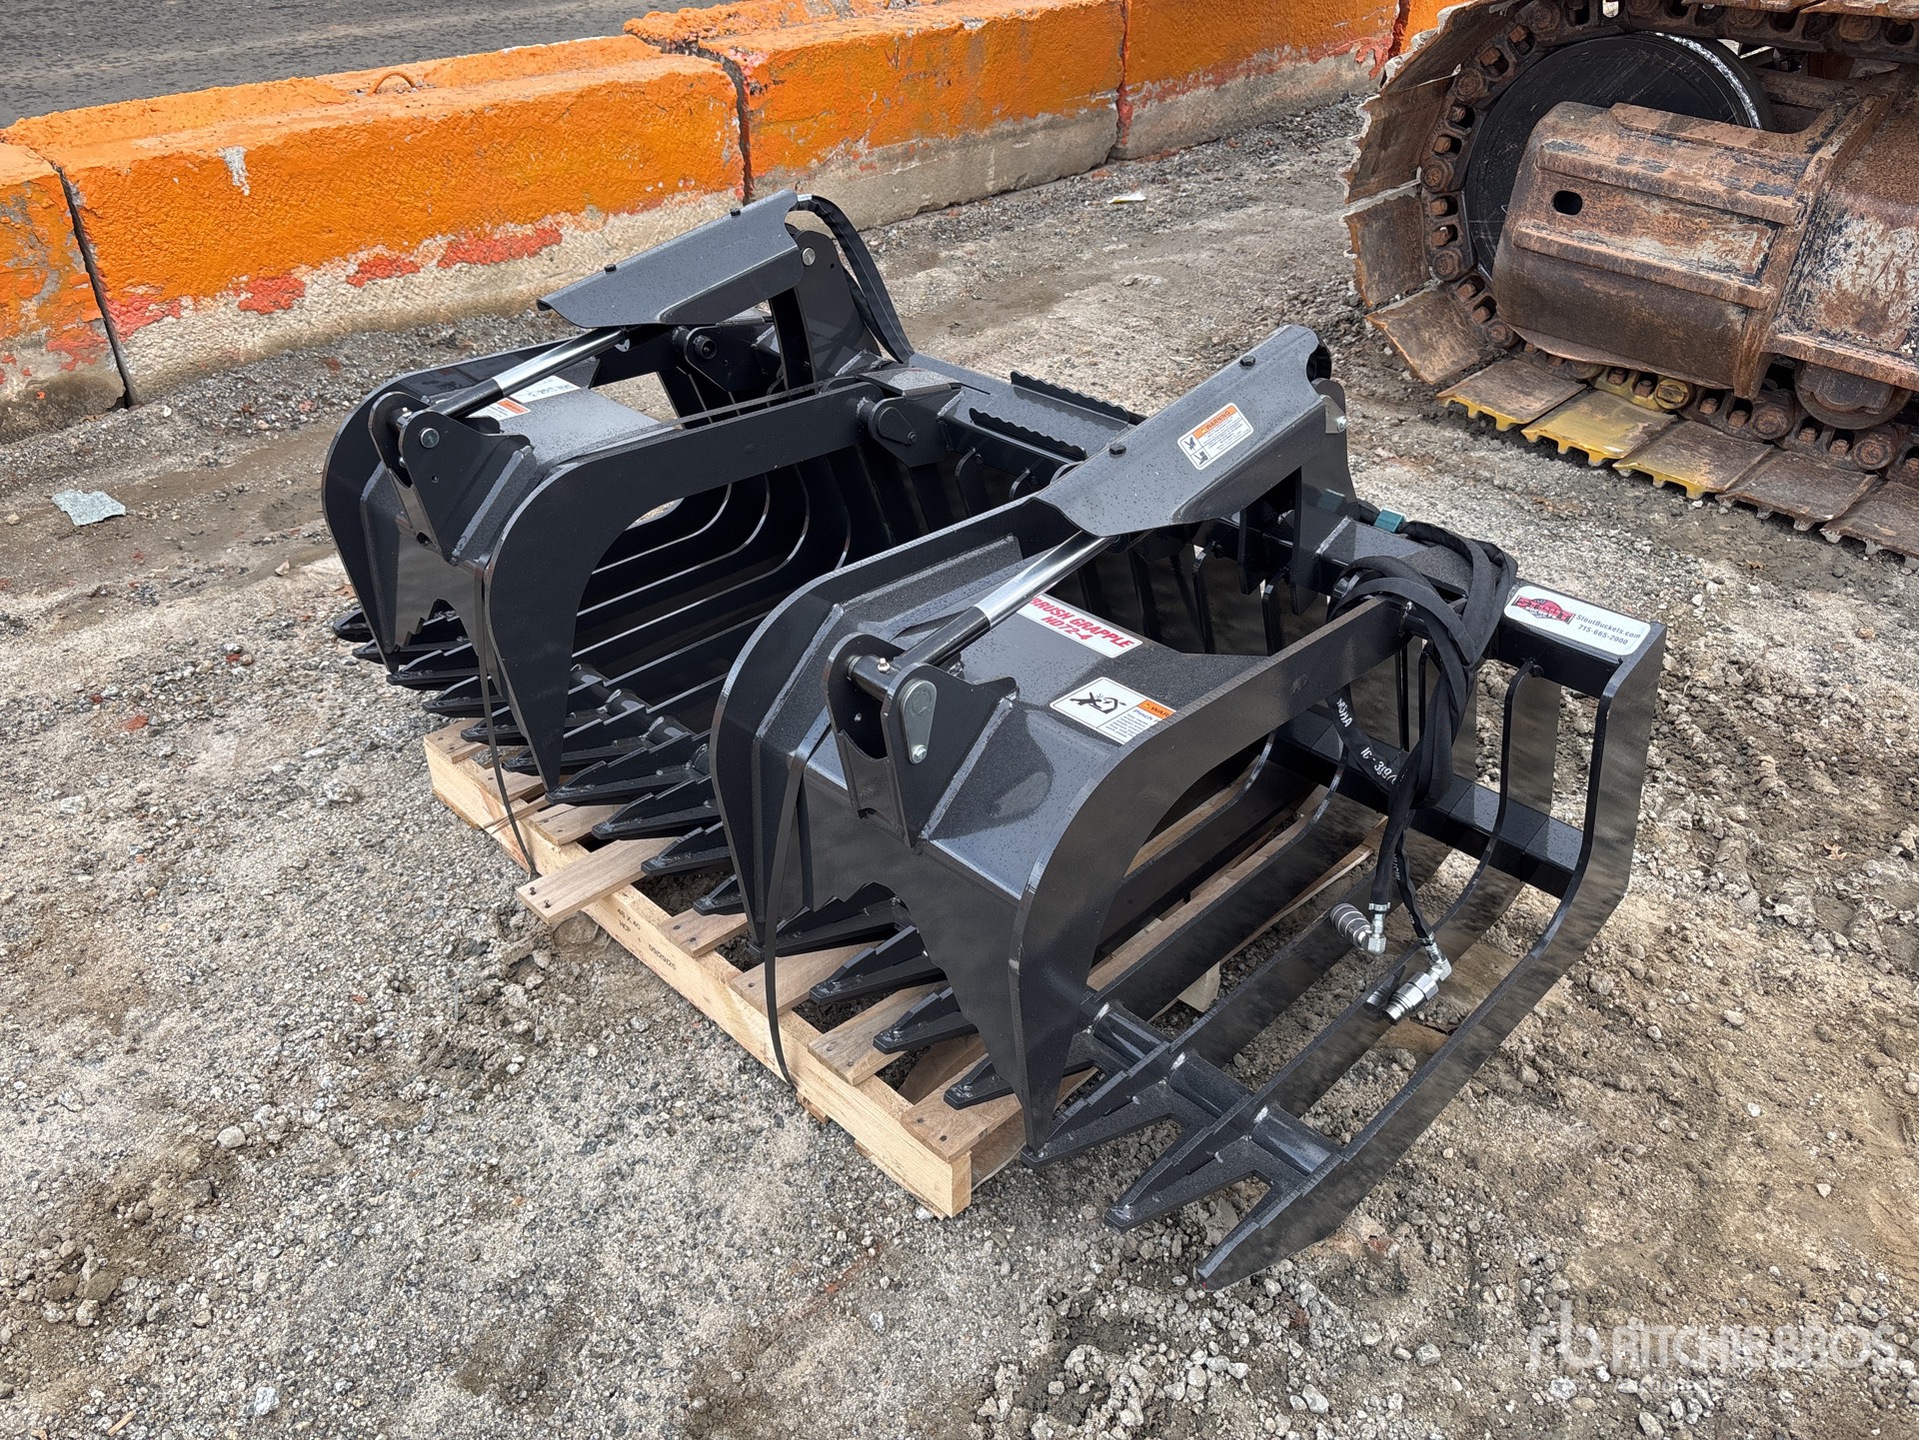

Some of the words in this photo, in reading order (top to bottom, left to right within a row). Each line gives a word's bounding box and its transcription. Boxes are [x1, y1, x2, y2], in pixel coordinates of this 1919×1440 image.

[1205, 409, 1231, 430] WARNING
[1030, 596, 1074, 619] BRUSH
[1070, 615, 1135, 648] GRAPPLE
[1041, 616, 1093, 641] HD72-4
[1576, 614, 1641, 639] StoutBuckets.com
[1578, 623, 1629, 646] 715-665-2000
[1336, 698, 1353, 728] MSHA
